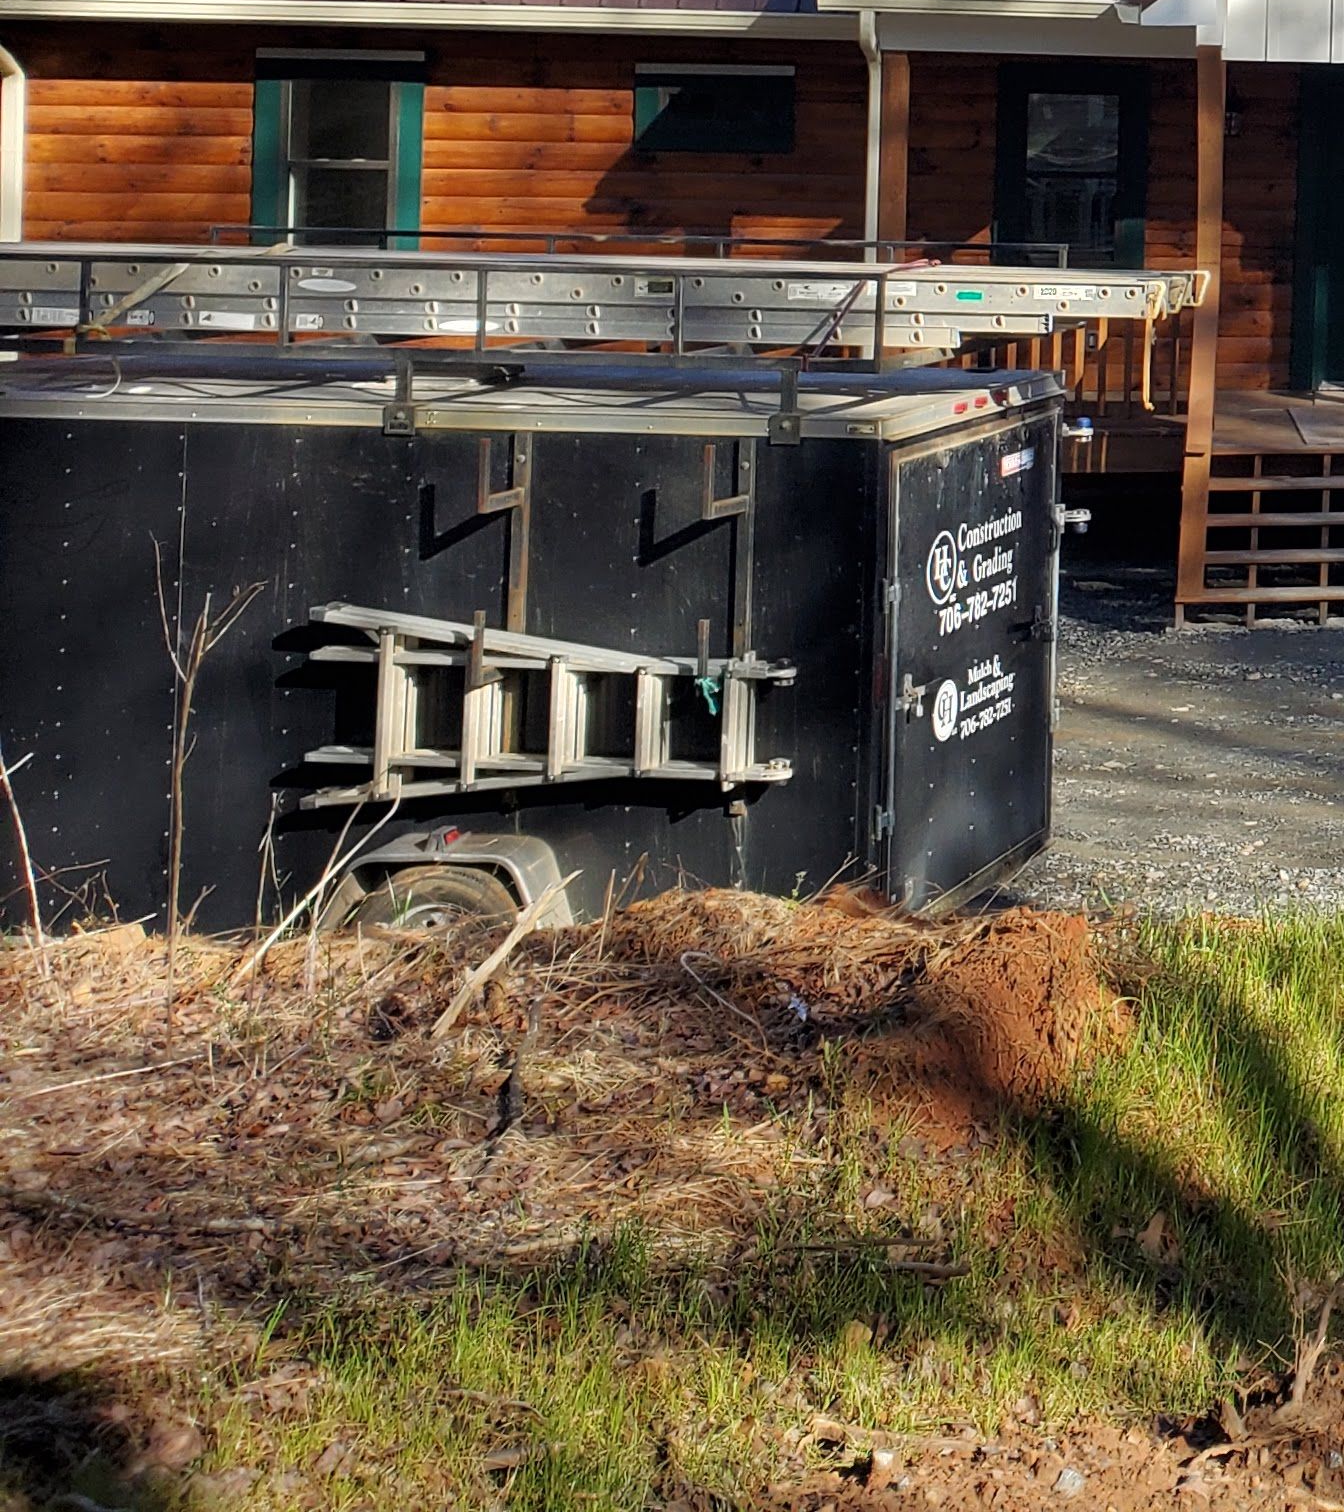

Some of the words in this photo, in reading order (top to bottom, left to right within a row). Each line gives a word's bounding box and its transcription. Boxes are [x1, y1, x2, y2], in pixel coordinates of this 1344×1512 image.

[957, 506, 1022, 552] Construction
[957, 560, 969, 589] &
[973, 545, 1014, 583] Grading
[938, 575, 1018, 637] 706-782-7251
[967, 659, 992, 686] Mulch
[993, 654, 1003, 678] &
[960, 673, 1015, 712] Landscaping
[960, 697, 1012, 740] 706-782-7251
